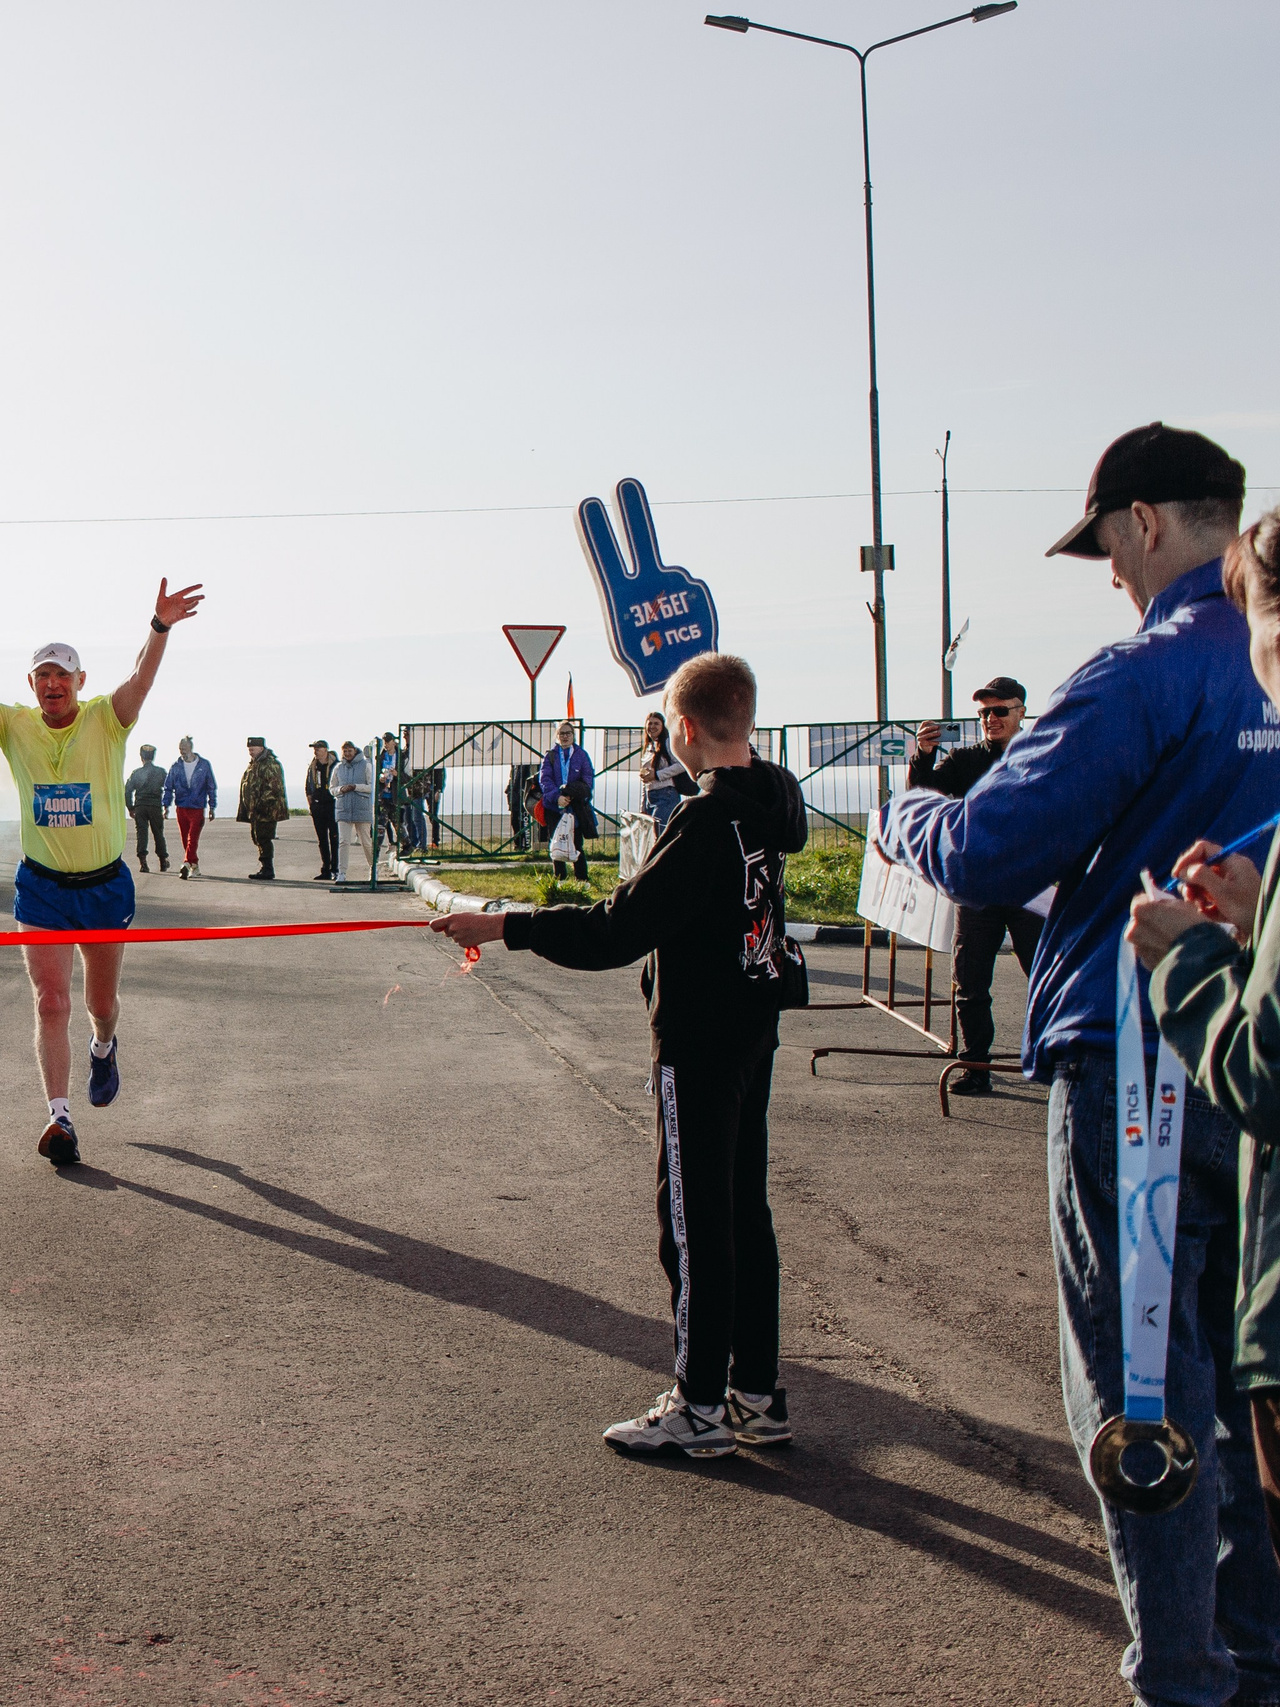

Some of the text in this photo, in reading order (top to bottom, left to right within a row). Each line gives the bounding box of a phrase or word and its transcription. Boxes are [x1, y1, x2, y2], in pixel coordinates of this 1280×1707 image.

[665, 624, 702, 646] ПСБ
[44, 797, 81, 813] 40001
[886, 871, 919, 915] ПСБ
[666, 1080, 678, 1139] OPEN YOURSELF
[1126, 1082, 1140, 1122] ПСБ
[1157, 1108, 1173, 1148] ПСБ
[674, 1180, 686, 1237] OPEN YOURSELF
